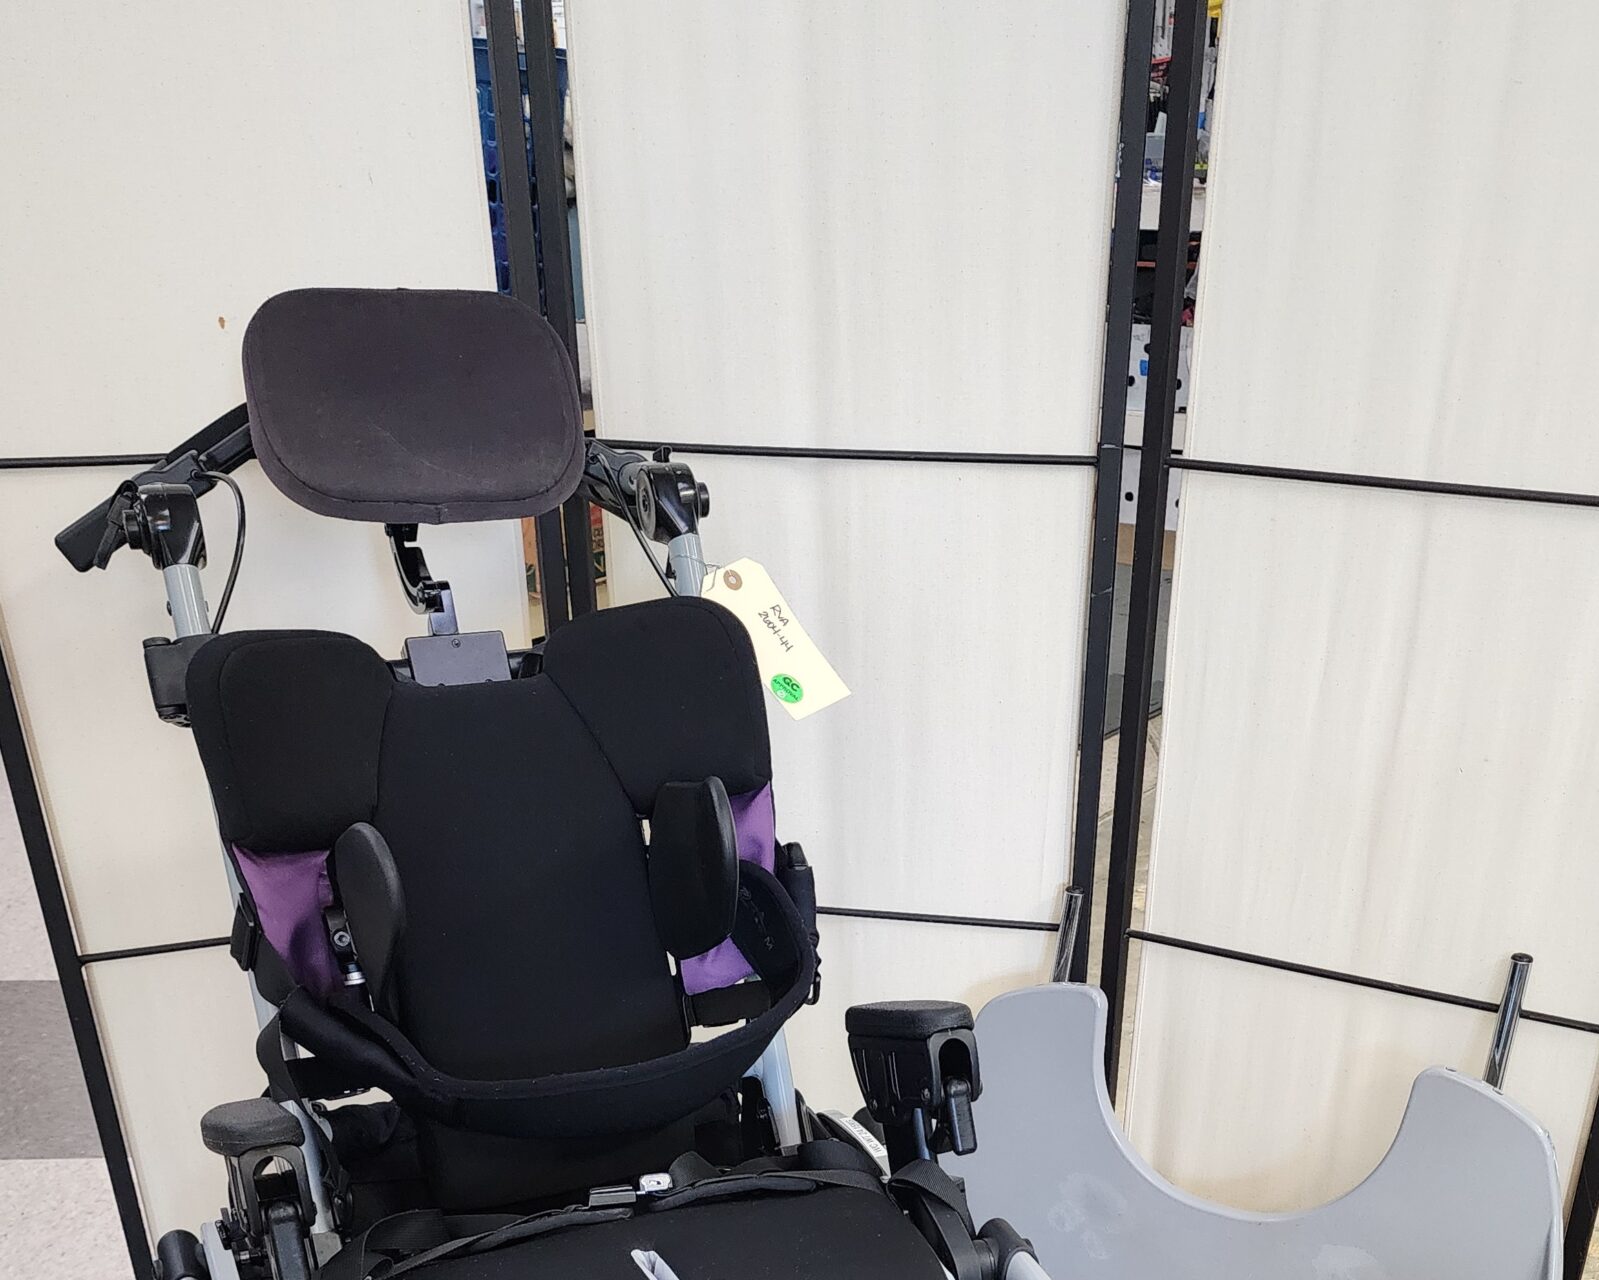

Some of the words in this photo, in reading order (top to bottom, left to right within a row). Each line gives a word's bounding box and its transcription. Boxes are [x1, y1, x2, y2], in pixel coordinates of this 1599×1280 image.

[770, 604, 789, 626] RVA
[772, 679, 799, 701] APPROVAL
[783, 677, 800, 692] QC
